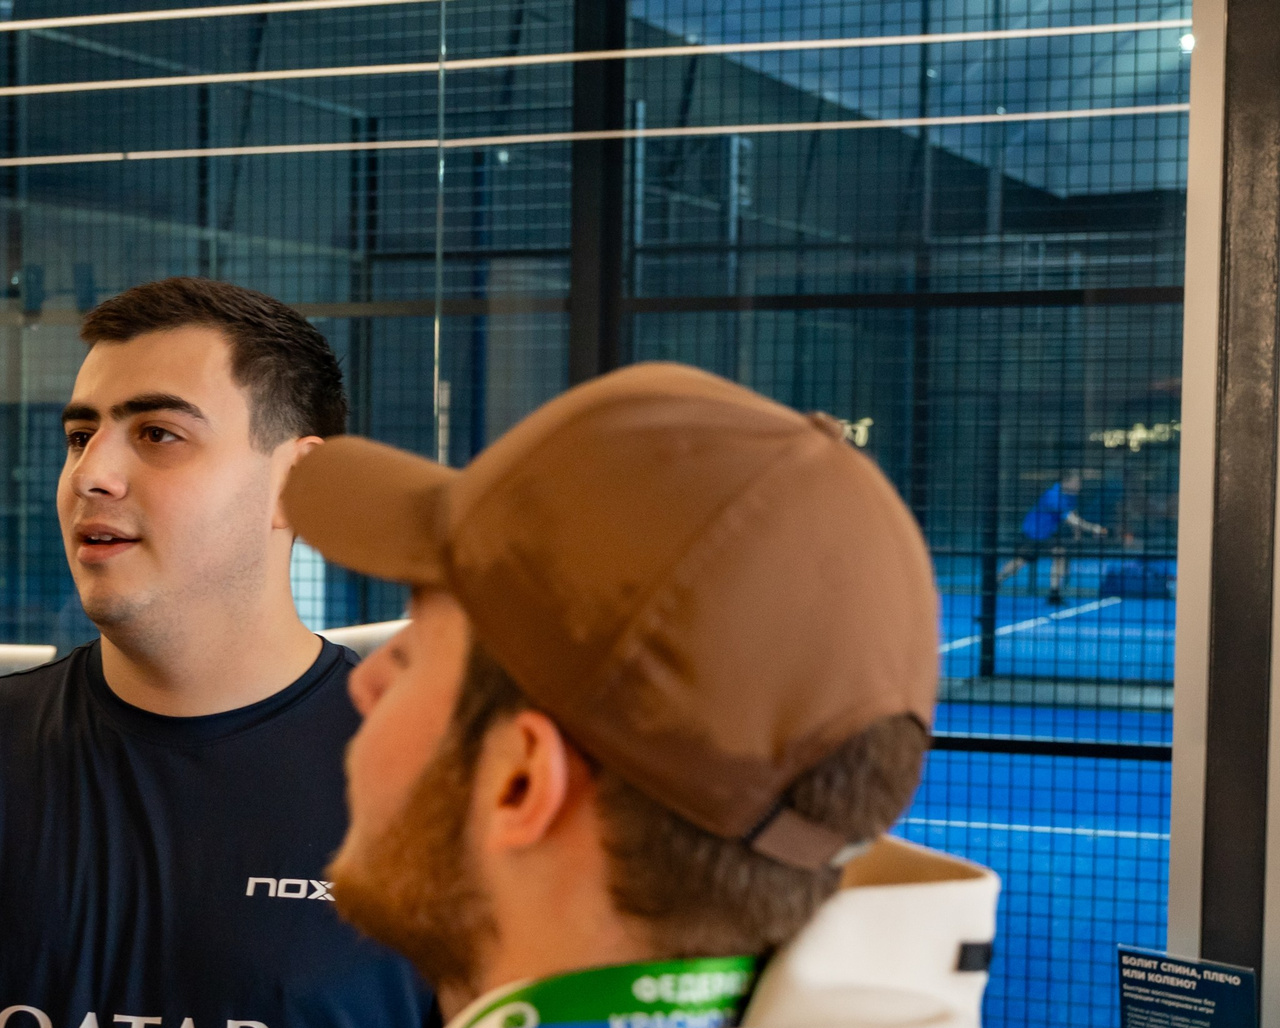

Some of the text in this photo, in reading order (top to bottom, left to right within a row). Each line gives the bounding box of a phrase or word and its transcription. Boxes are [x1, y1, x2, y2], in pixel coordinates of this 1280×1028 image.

[1122, 955, 1241, 986] БОЛИТ СПИНА, ПЛЕЧО
[1122, 968, 1197, 990] ИЛИ КОЛЕНО?
